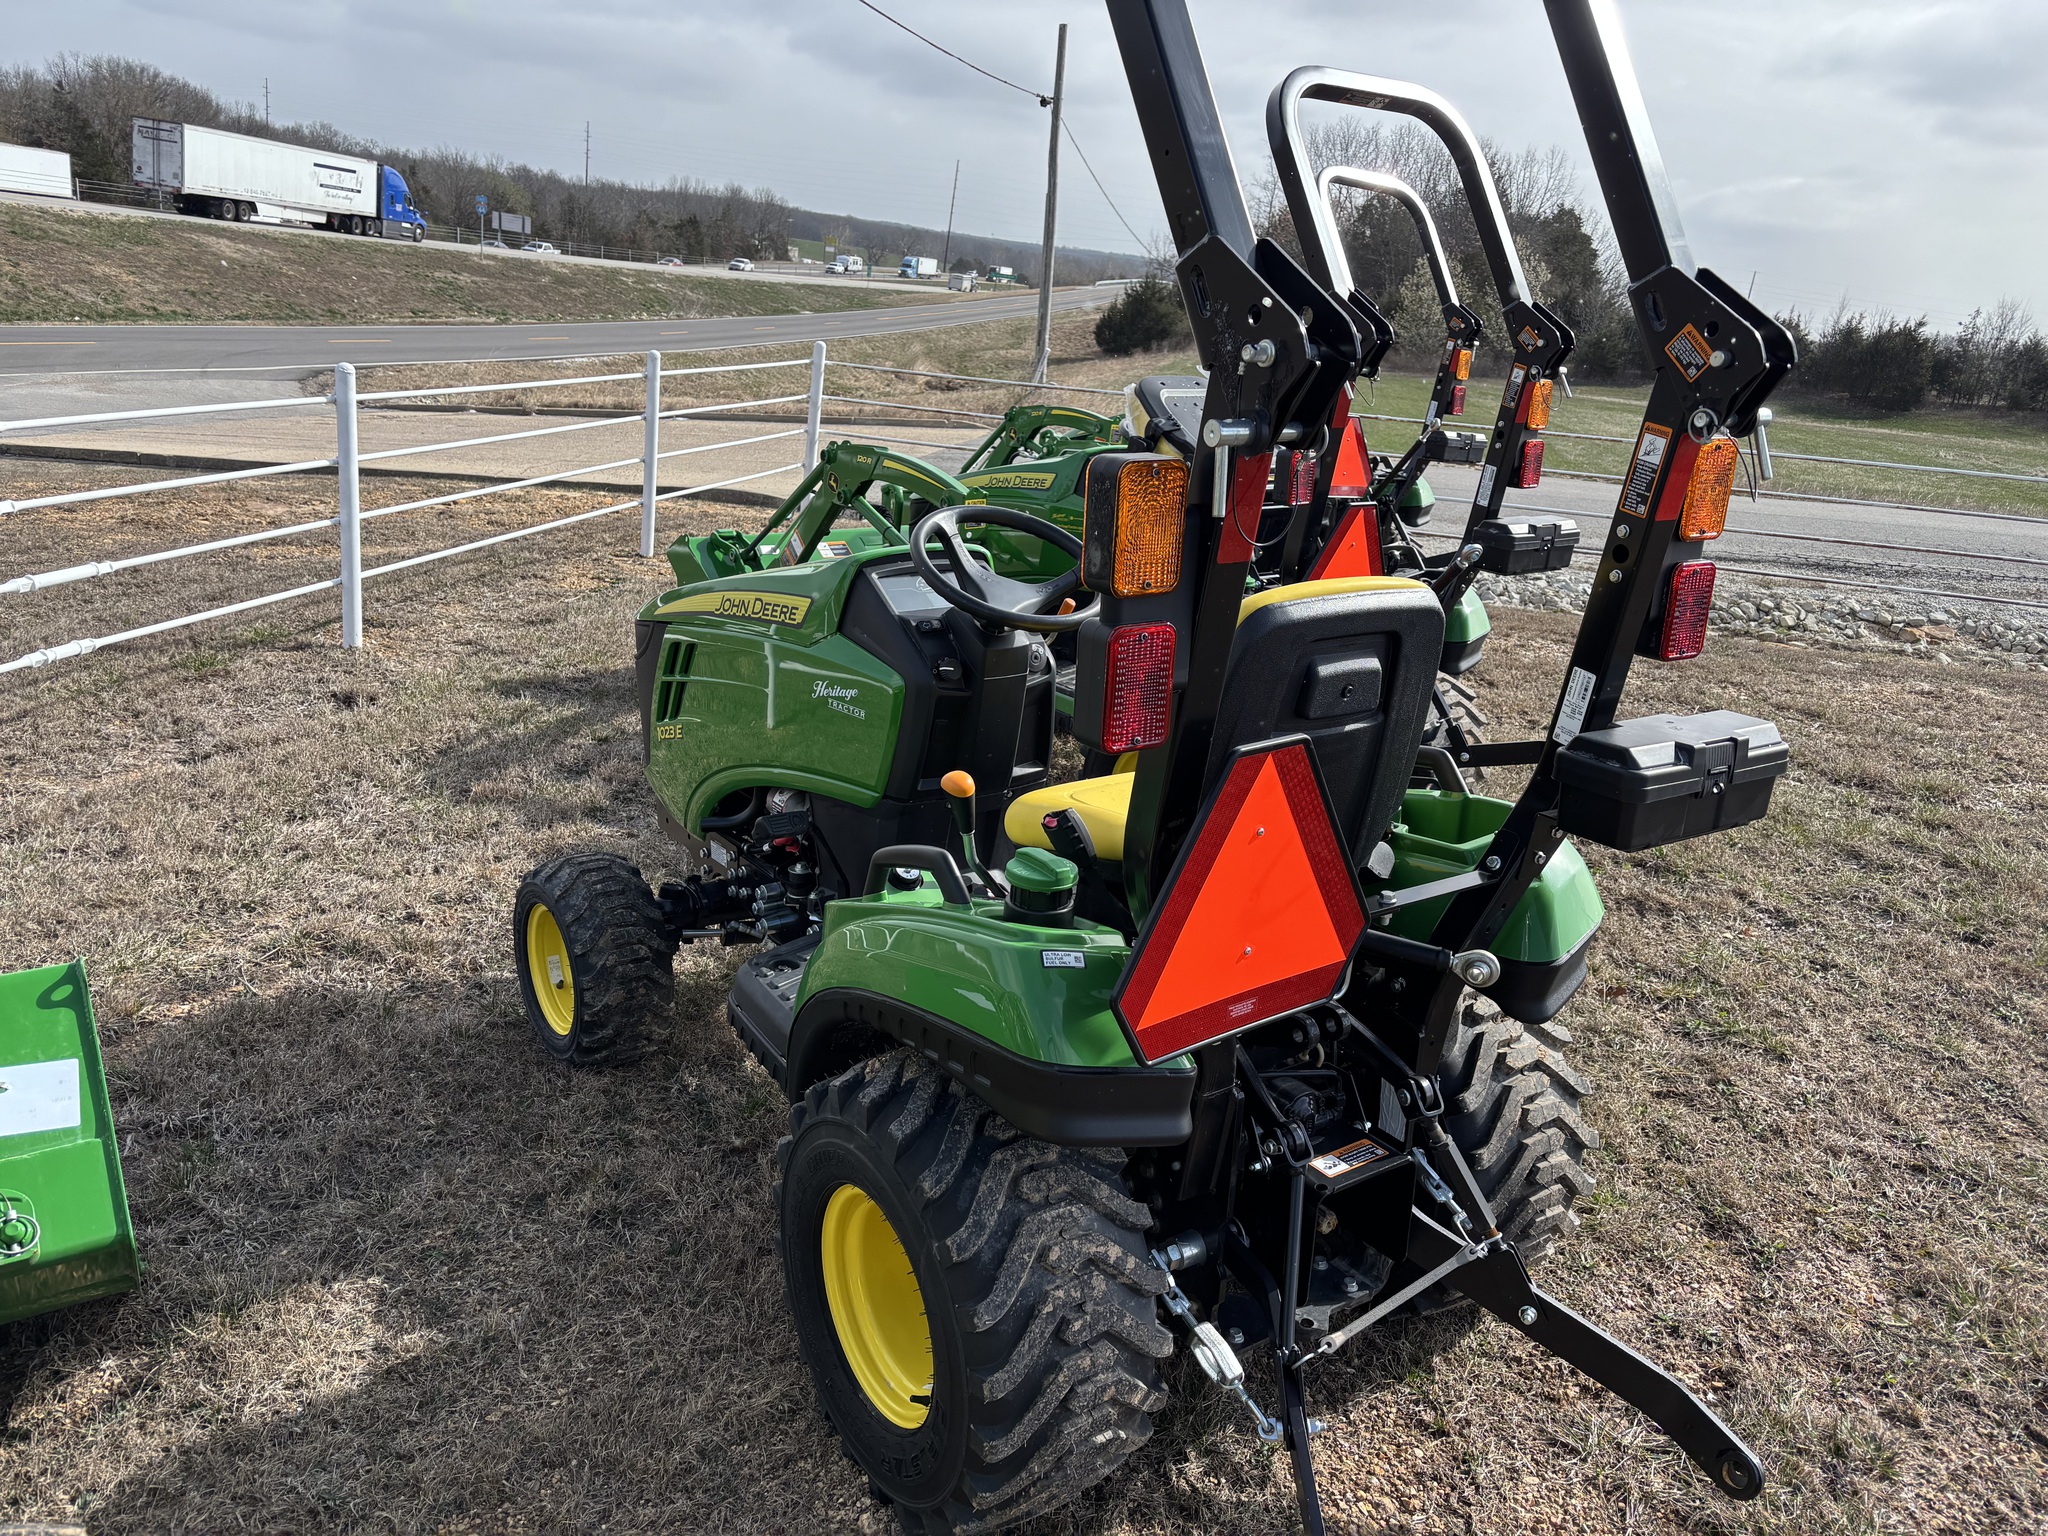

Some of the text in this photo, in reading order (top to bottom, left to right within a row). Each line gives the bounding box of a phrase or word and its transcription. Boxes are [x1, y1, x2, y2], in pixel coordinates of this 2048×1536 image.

[984, 476, 1048, 488] JOHN DEERE
[714, 595, 799, 623] JOHN DEERE
[811, 680, 859, 701] Heritage
[828, 699, 866, 719] TRACTOR
